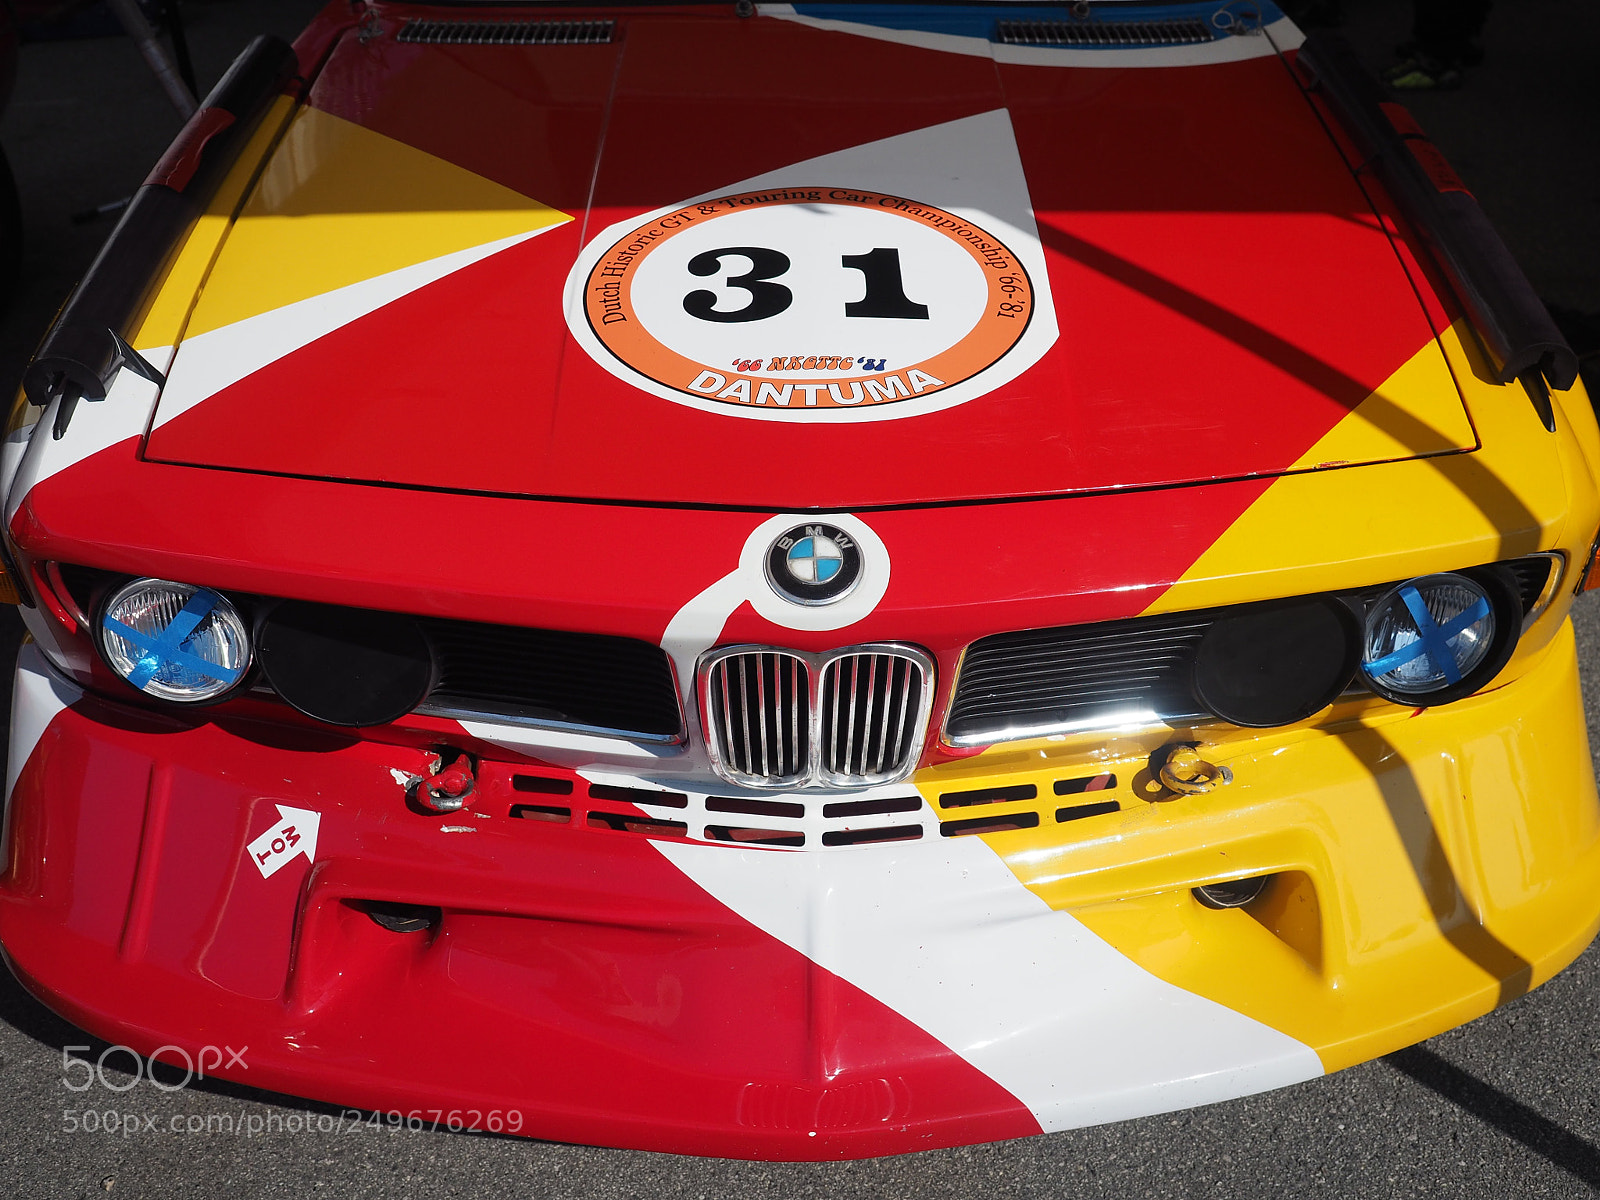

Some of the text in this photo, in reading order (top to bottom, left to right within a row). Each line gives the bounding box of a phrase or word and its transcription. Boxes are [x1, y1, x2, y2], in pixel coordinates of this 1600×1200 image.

[697, 205, 720, 215] &
[718, 189, 822, 209] Touring
[828, 190, 872, 204] Car
[660, 211, 695, 229] GT
[878, 197, 1010, 269] Championship
[601, 229, 664, 277] Historic
[594, 281, 627, 325] Dutch
[687, 368, 947, 407] DANTUMA
[777, 526, 854, 551] BMW
[256, 825, 302, 866] TOW
